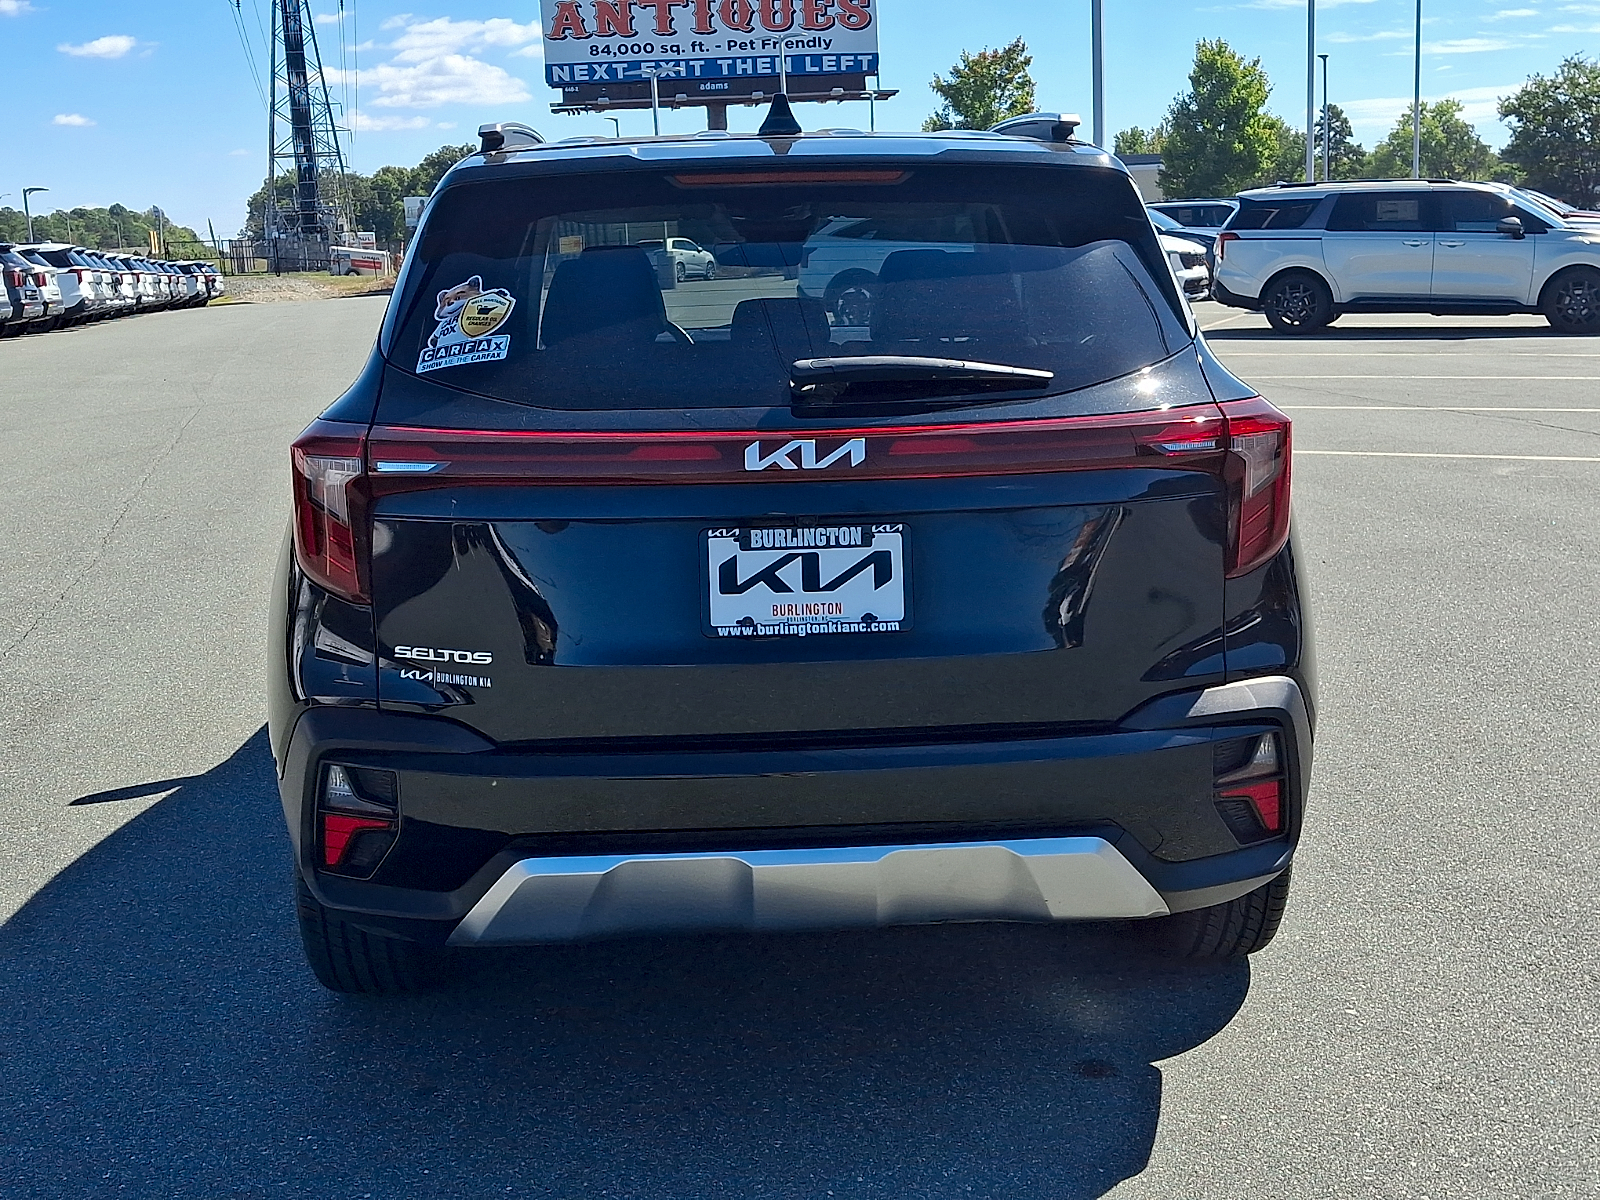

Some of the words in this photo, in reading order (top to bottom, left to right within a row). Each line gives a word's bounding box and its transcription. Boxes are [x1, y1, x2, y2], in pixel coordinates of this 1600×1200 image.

[545, 0, 873, 41] ANTIQUES
[589, 42, 655, 58] 84,000
[660, 44, 686, 56] sq.
[691, 41, 710, 53] ft.
[726, 39, 756, 52] Pet
[761, 36, 833, 51] Frendly
[551, 63, 629, 83] NEXT
[639, 60, 706, 79] EXIT
[716, 56, 793, 76] THEN
[805, 55, 873, 73] LEFT
[700, 81, 729, 91] adams
[439, 323, 458, 337] FOX
[424, 340, 504, 361] CARFAX
[421, 360, 444, 371] SHOW
[456, 355, 469, 364] THE
[470, 352, 502, 362] CARFAX
[744, 437, 866, 471] KIA
[708, 528, 740, 538] KIA
[750, 526, 862, 548] BURLINGTON
[871, 523, 903, 533] KIA
[718, 550, 893, 595] KIA
[772, 602, 842, 617] BURLINGTON
[717, 621, 900, 637] www.burlingtonkianc.com
[393, 645, 493, 665] SELTOS
[400, 668, 433, 681] KIA
[436, 672, 478, 687] BURLINGTON
[479, 676, 492, 688] KIA
